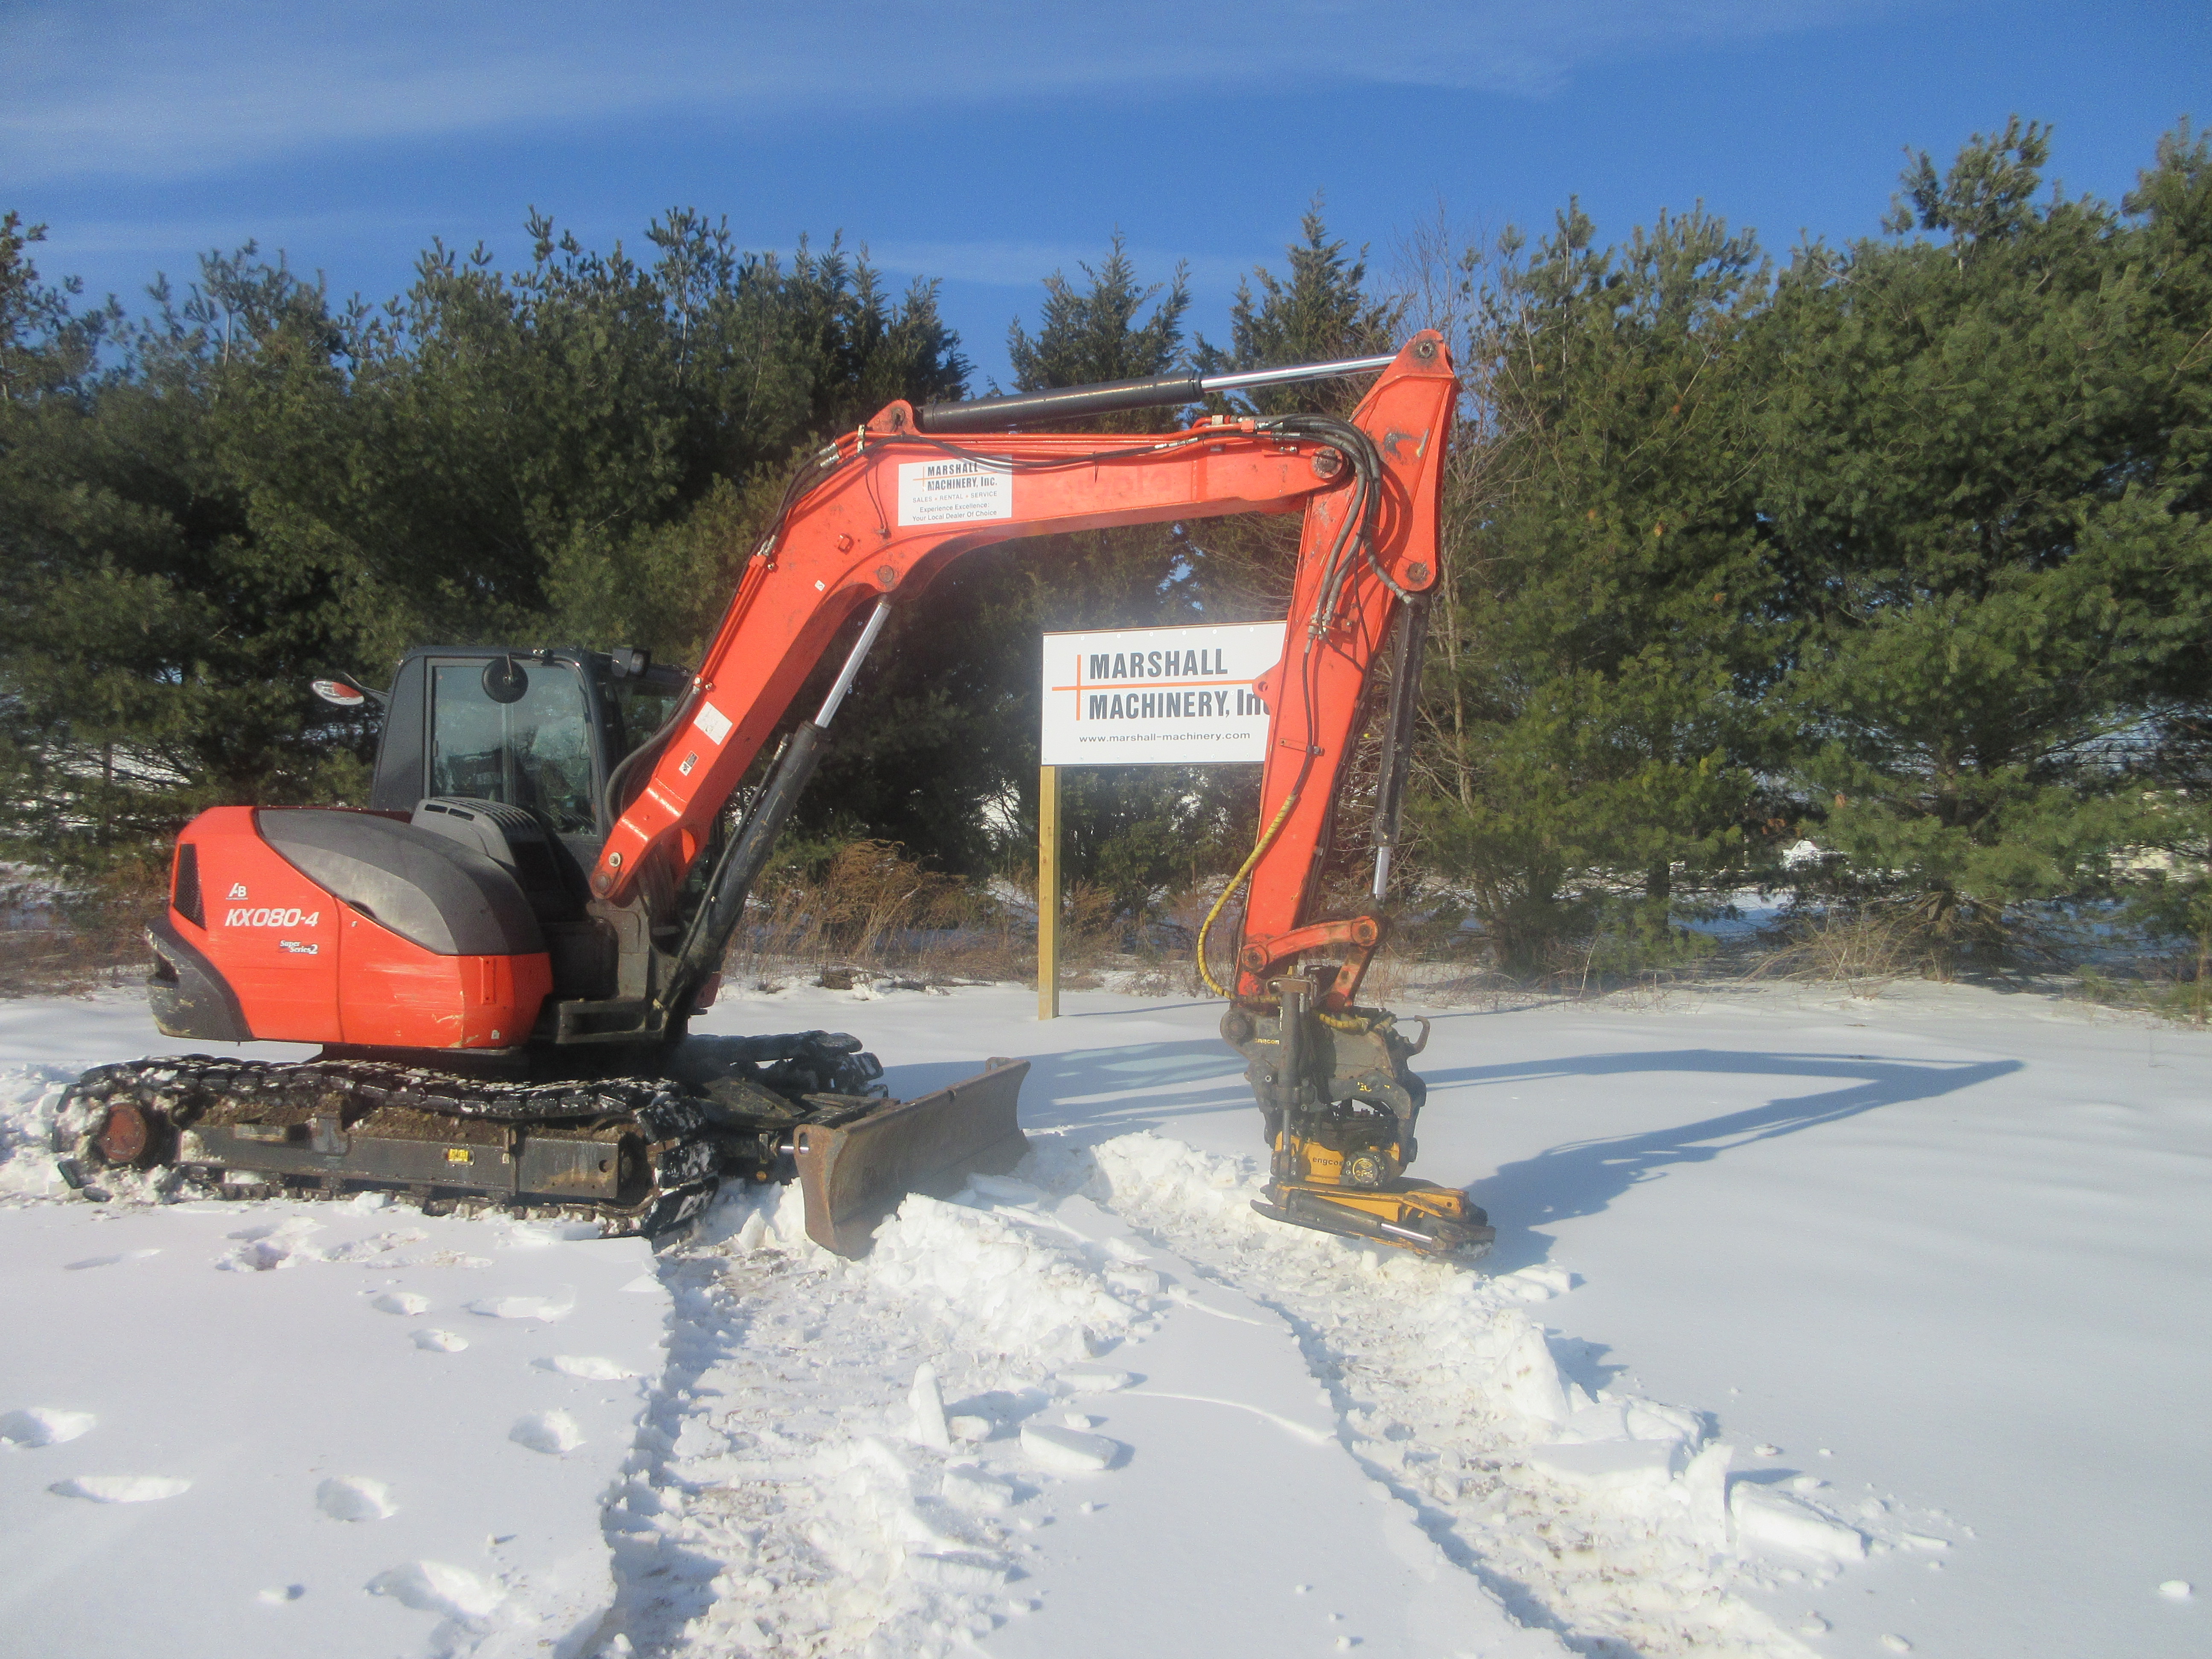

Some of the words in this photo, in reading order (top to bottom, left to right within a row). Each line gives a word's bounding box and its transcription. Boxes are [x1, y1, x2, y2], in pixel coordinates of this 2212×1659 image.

[928, 463, 978, 476] MARSHALL
[928, 477, 978, 491] MACHINERY,
[981, 477, 997, 486] Inc.
[920, 505, 953, 513] Experience
[1090, 648, 1228, 679] MARSHALL
[1089, 690, 1230, 720] MACHINERY,
[1079, 731, 1250, 742] www.marshall-machinery.com
[224, 908, 320, 927] KX080-4
